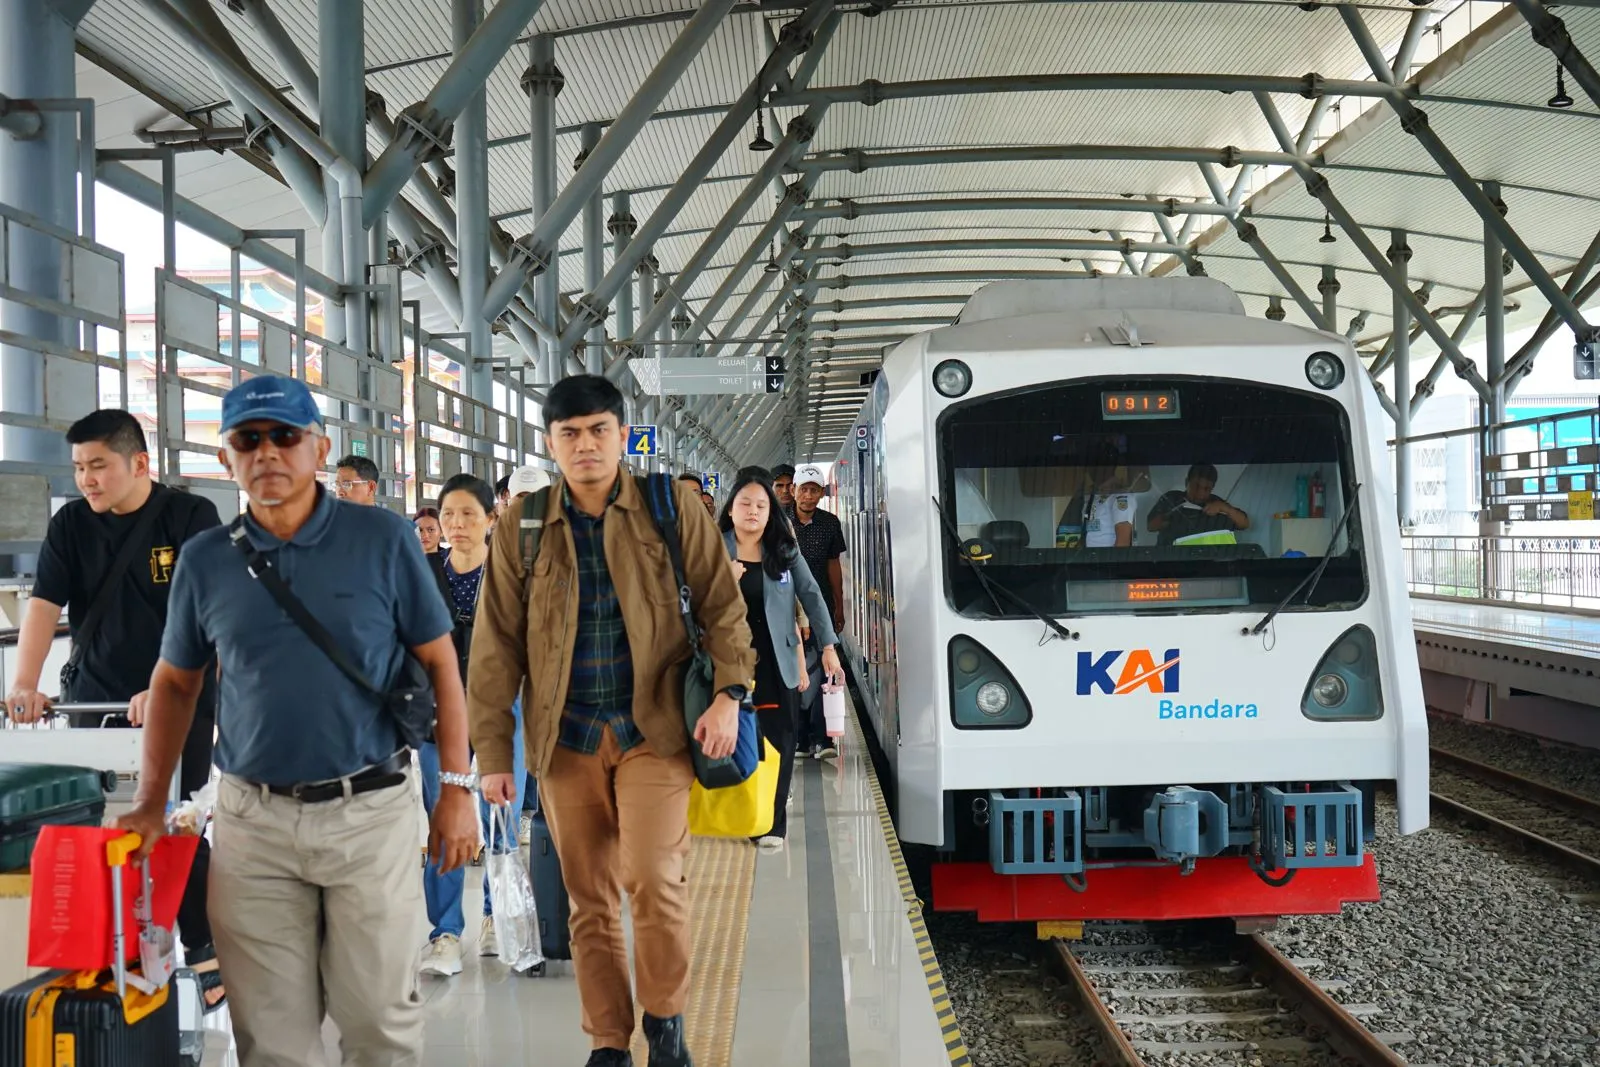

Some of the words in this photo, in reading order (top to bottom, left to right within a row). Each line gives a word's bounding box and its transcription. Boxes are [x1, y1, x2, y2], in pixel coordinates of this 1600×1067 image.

[718, 359, 746, 367] KELUAR
[719, 377, 743, 385] TOILET
[1108, 396, 1169, 411] 0912
[635, 434, 651, 455] 4
[708, 477, 717, 489] 3
[1076, 649, 1180, 695] KAI
[1159, 699, 1258, 719] Bandara
